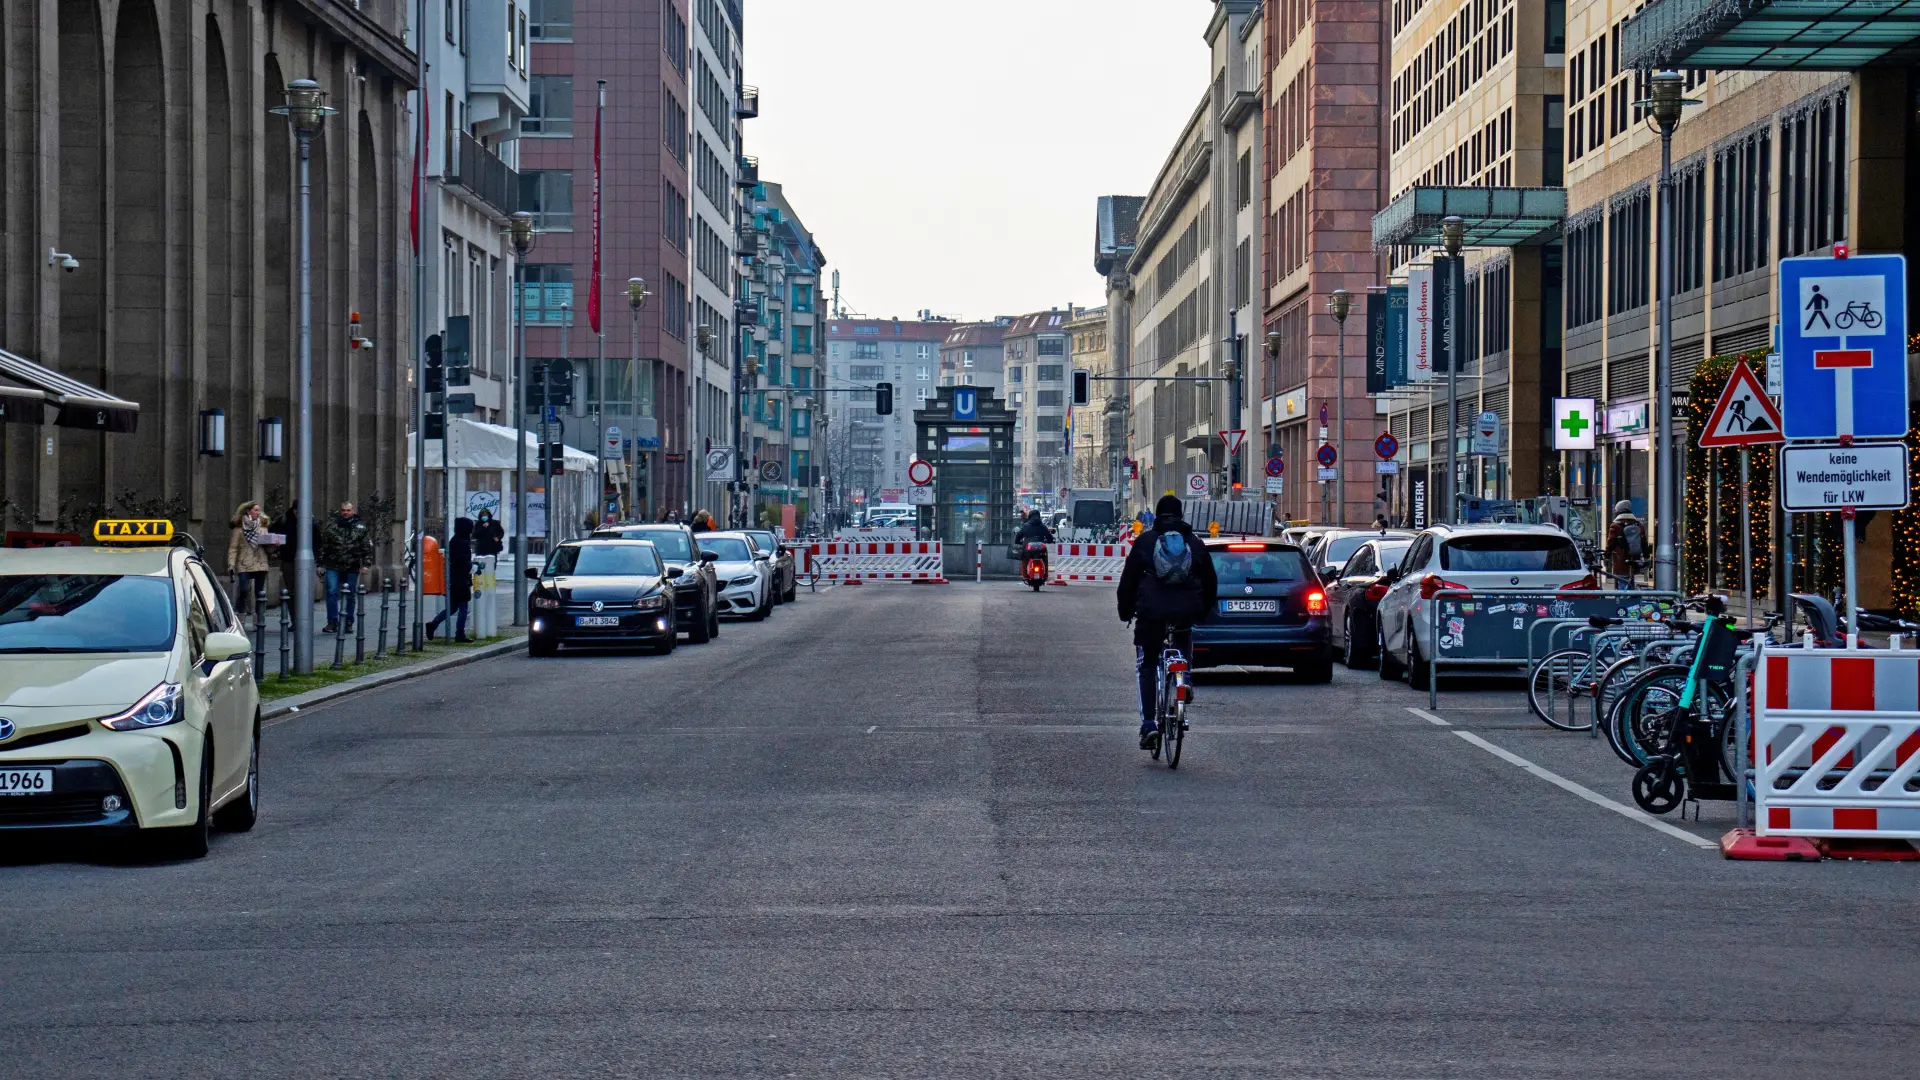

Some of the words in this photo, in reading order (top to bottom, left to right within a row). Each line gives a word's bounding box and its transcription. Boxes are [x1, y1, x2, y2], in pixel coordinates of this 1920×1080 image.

[1417, 280, 1432, 322] Johnson
[1376, 312, 1385, 375] MINDSPACE
[1416, 328, 1432, 370] Johnson
[957, 393, 974, 415] U
[712, 455, 725, 466] 30
[1829, 452, 1857, 465] keine
[1797, 469, 1891, 485] Wendemöglichkeit
[1823, 490, 1838, 503] für
[1842, 490, 1865, 503] LKW
[465, 498, 500, 513] Seaside
[609, 502, 616, 512] P
[107, 522, 159, 535] TAXI
[1227, 601, 1234, 611] B
[1239, 601, 1251, 611] CB
[1252, 601, 1276, 611] 1978
[589, 617, 599, 625] MI
[600, 617, 618, 625] 3842
[0, 772, 44, 790] 1966
